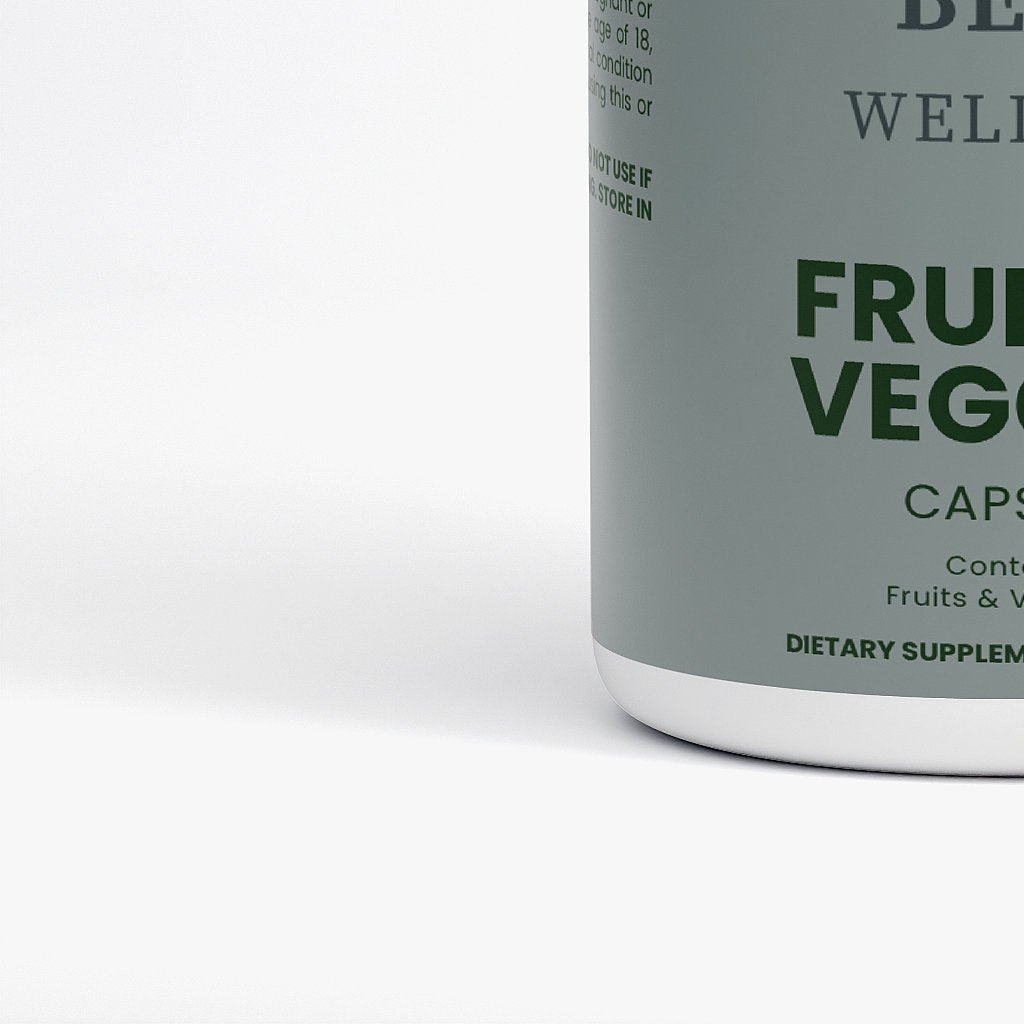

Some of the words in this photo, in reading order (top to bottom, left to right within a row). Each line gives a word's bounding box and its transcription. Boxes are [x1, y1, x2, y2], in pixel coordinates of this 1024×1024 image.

[637, 1, 652, 19] or
[594, 16, 612, 44] age
[617, 24, 629, 45] of
[635, 27, 653, 55] 18,
[596, 50, 652, 85] condition
[610, 84, 632, 112] this
[637, 98, 652, 117] or
[593, 147, 611, 176] NOT
[613, 159, 636, 186] USE
[640, 167, 653, 188] IF
[598, 182, 633, 216] STORE
[637, 198, 652, 221] IN
[886, 585, 967, 609] Fruits
[977, 587, 999, 609] &
[786, 633, 896, 660] DIETARY
